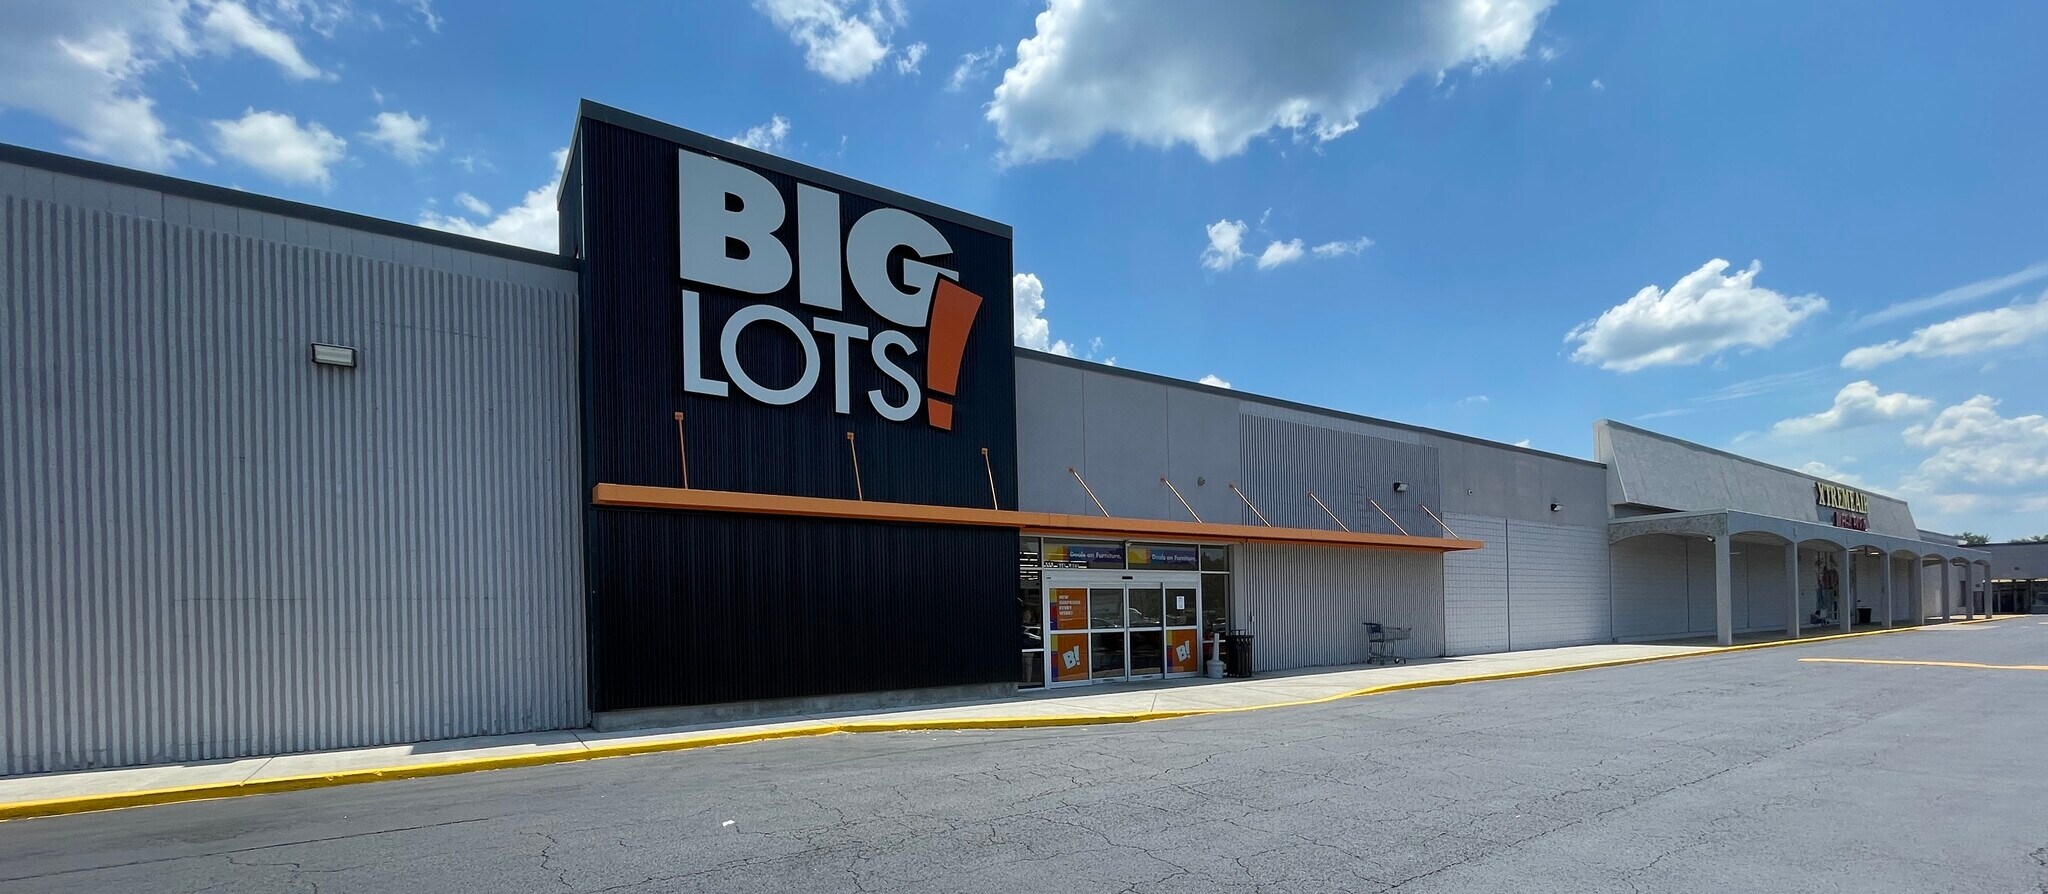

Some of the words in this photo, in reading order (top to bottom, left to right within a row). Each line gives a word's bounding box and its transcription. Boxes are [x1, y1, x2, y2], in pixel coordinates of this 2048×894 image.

[679, 149, 959, 328] BIG
[1817, 482, 1855, 511] XTREME
[1062, 645, 1080, 669] B!
[1176, 640, 1191, 662] B!
